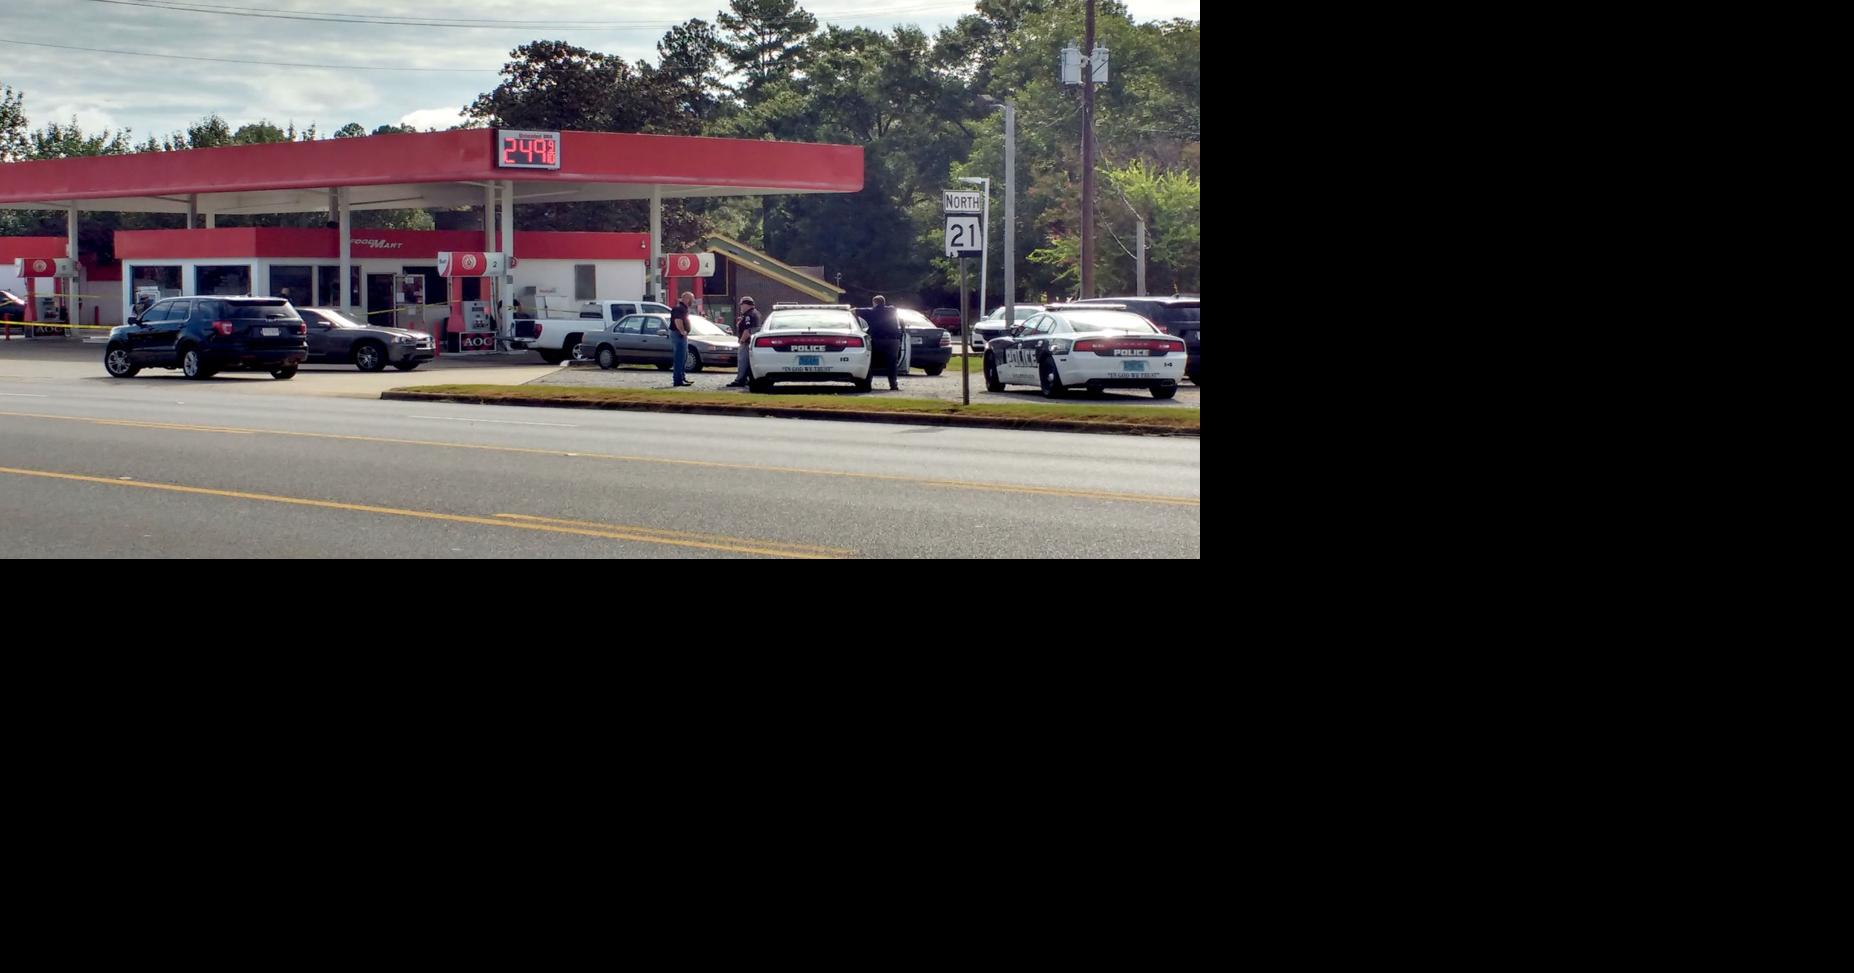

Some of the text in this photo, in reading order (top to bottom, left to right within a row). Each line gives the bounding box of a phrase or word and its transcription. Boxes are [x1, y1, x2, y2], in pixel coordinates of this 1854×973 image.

[946, 194, 979, 209] NORTH
[950, 223, 974, 247] 21
[463, 337, 493, 347] AOC
[1005, 349, 1037, 367] POLICE
[1113, 349, 1150, 357] POLICE
